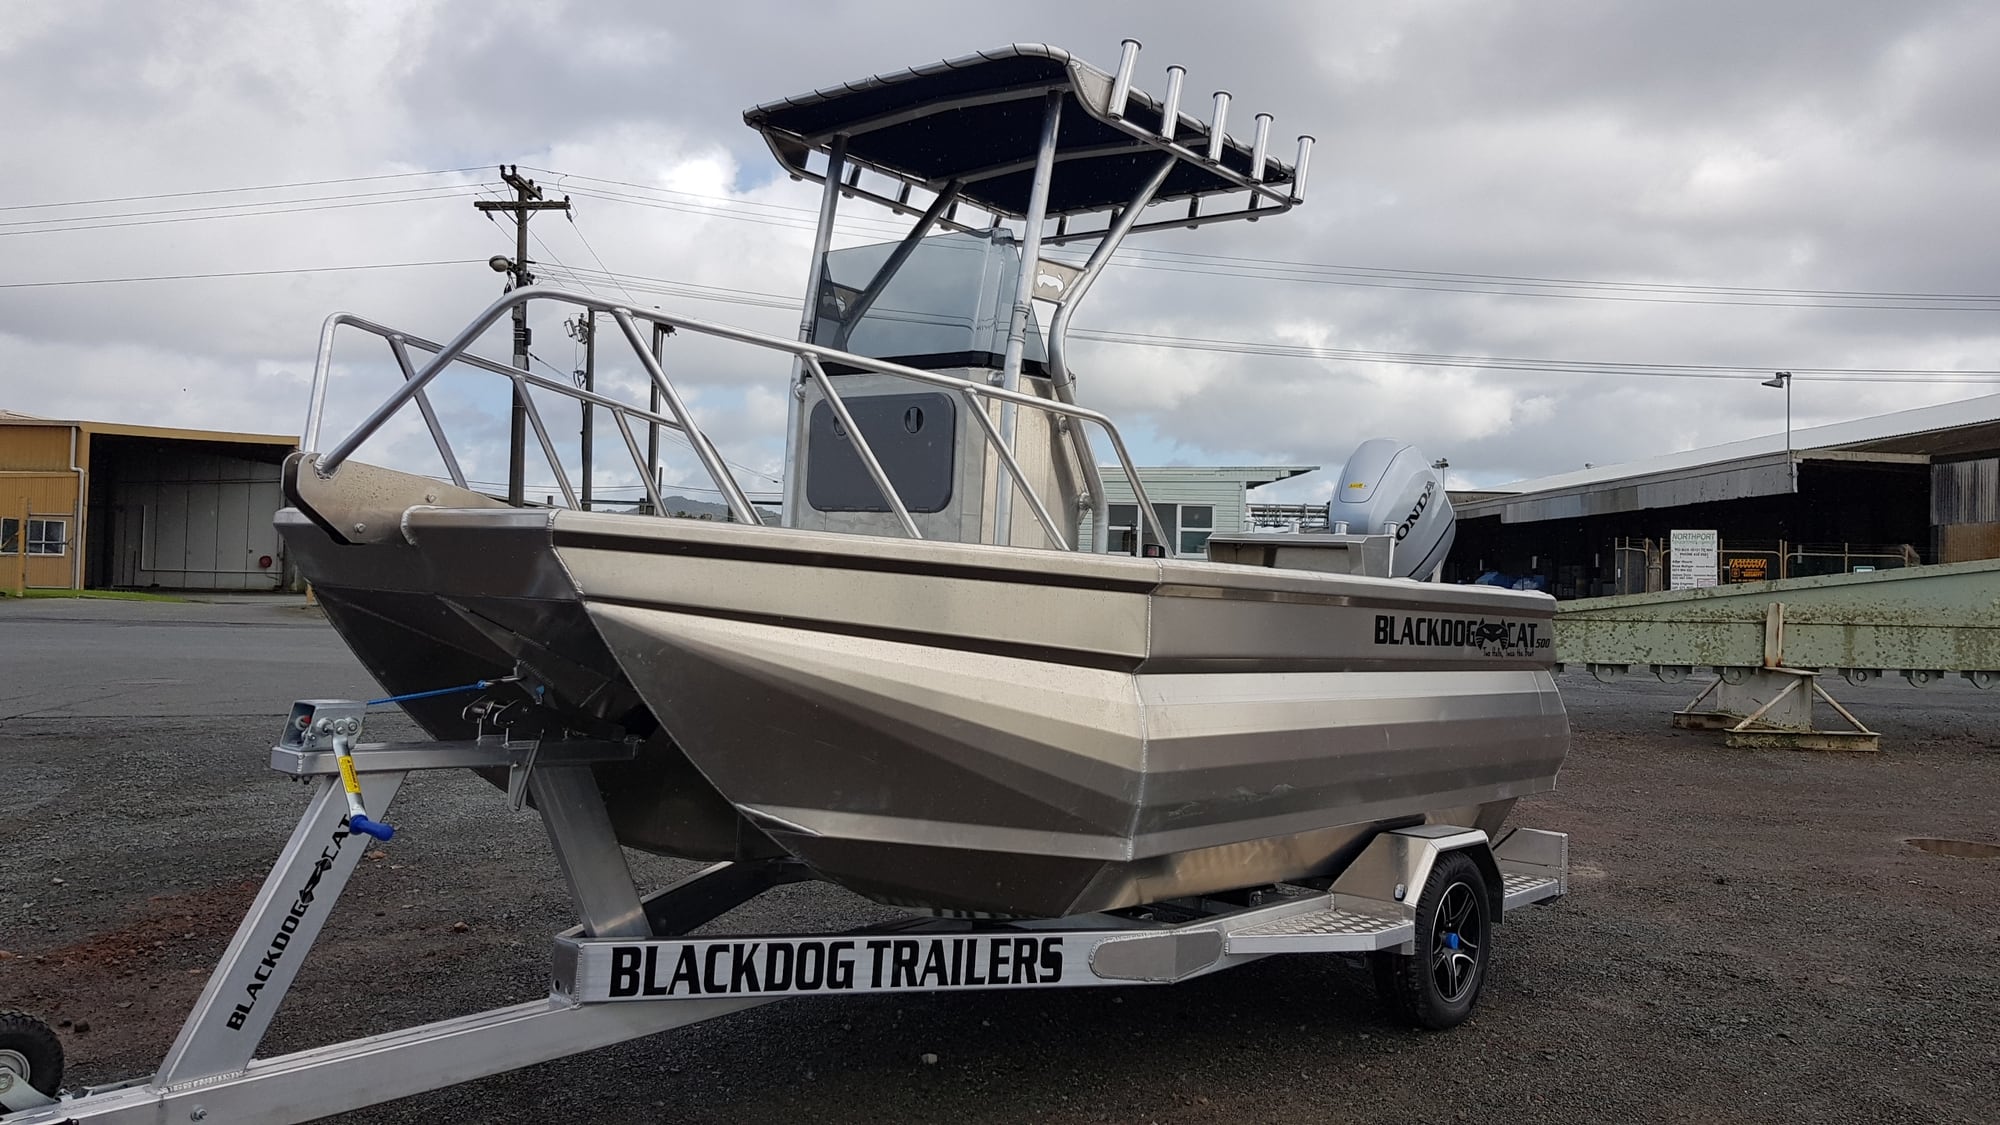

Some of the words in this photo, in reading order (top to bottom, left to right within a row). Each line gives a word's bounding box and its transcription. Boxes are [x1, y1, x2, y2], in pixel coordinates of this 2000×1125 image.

[1395, 480, 1435, 547] ONDA
[1672, 532, 1716, 541] NORTHPORT
[1374, 615, 1478, 647] BLACKDOG
[1508, 622, 1538, 648] CAT
[1535, 638, 1551, 649] 500
[226, 899, 309, 1032] BLACKDOG
[608, 940, 856, 998] BLACKDOG
[866, 936, 1064, 987] TRAILERS
